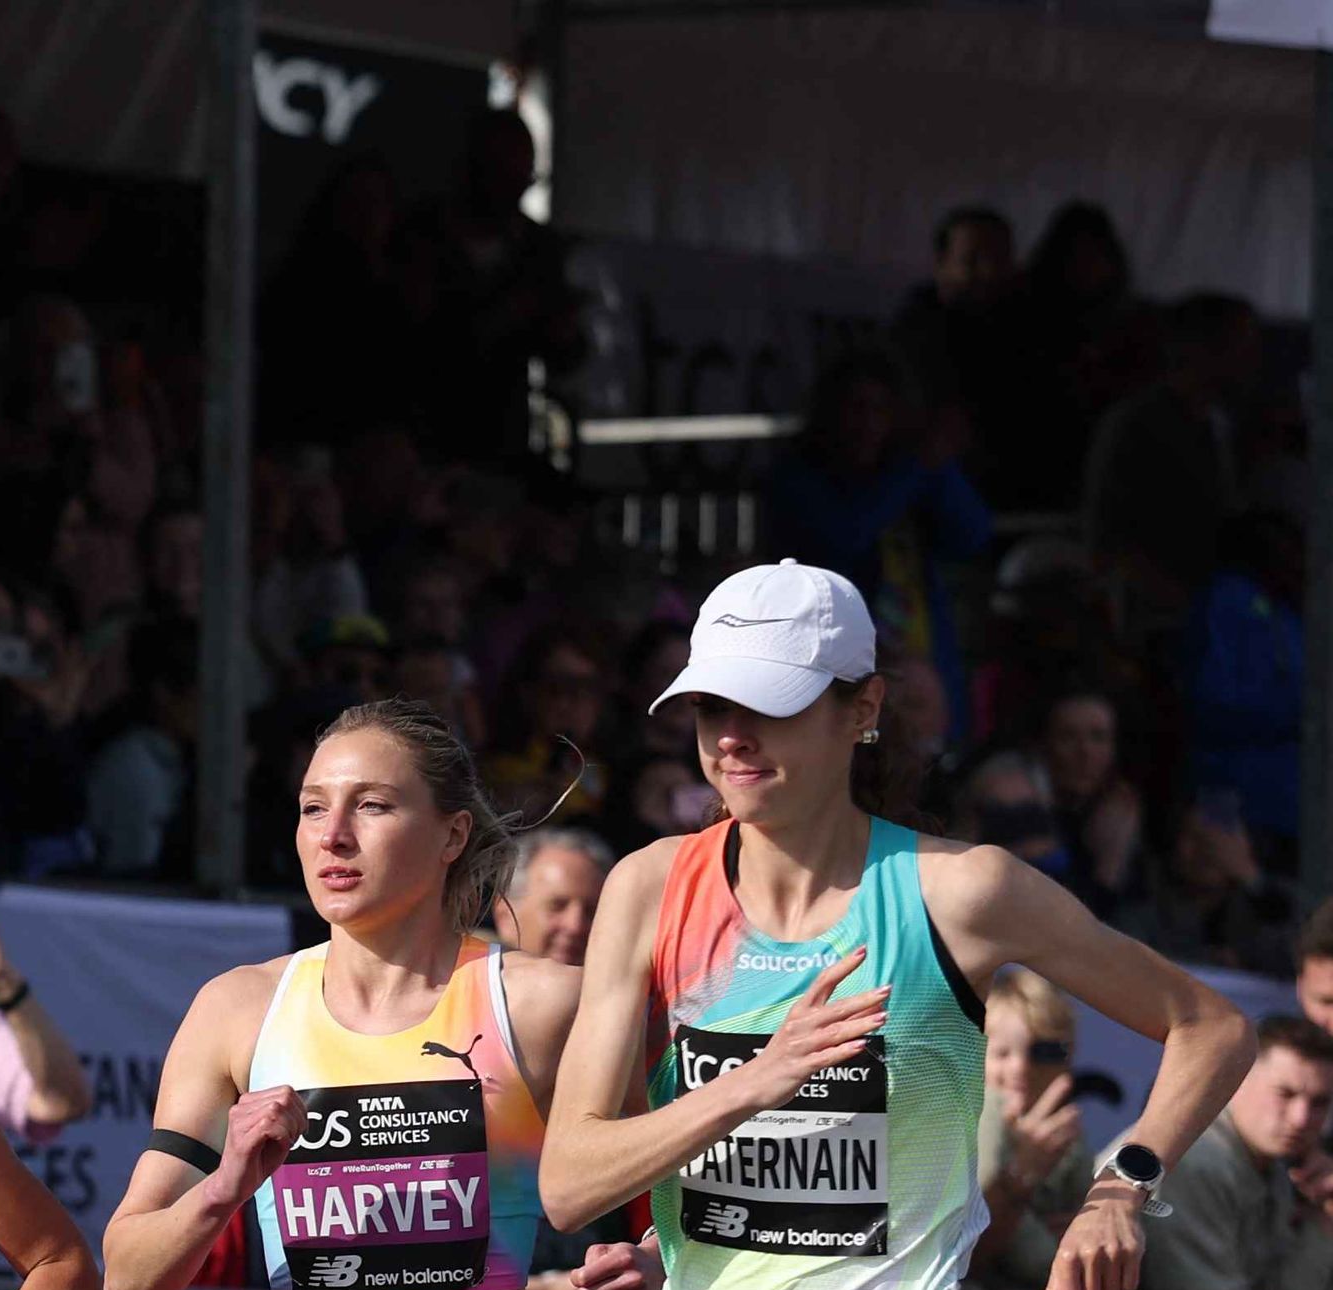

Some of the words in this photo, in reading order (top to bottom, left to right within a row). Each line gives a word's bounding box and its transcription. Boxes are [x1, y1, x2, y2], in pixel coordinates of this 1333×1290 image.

[289, 1110, 352, 1150] cs
[358, 1096, 405, 1112] TATA
[359, 1109, 470, 1129] CONSULTANCY
[360, 1129, 431, 1147] SERVICES
[342, 1162, 412, 1174] #WeRunTogether
[283, 1176, 481, 1237] HARVEY
[750, 1229, 785, 1244] new
[788, 1228, 867, 1247] balance
[365, 1271, 401, 1286] new
[403, 1267, 474, 1285] balance
